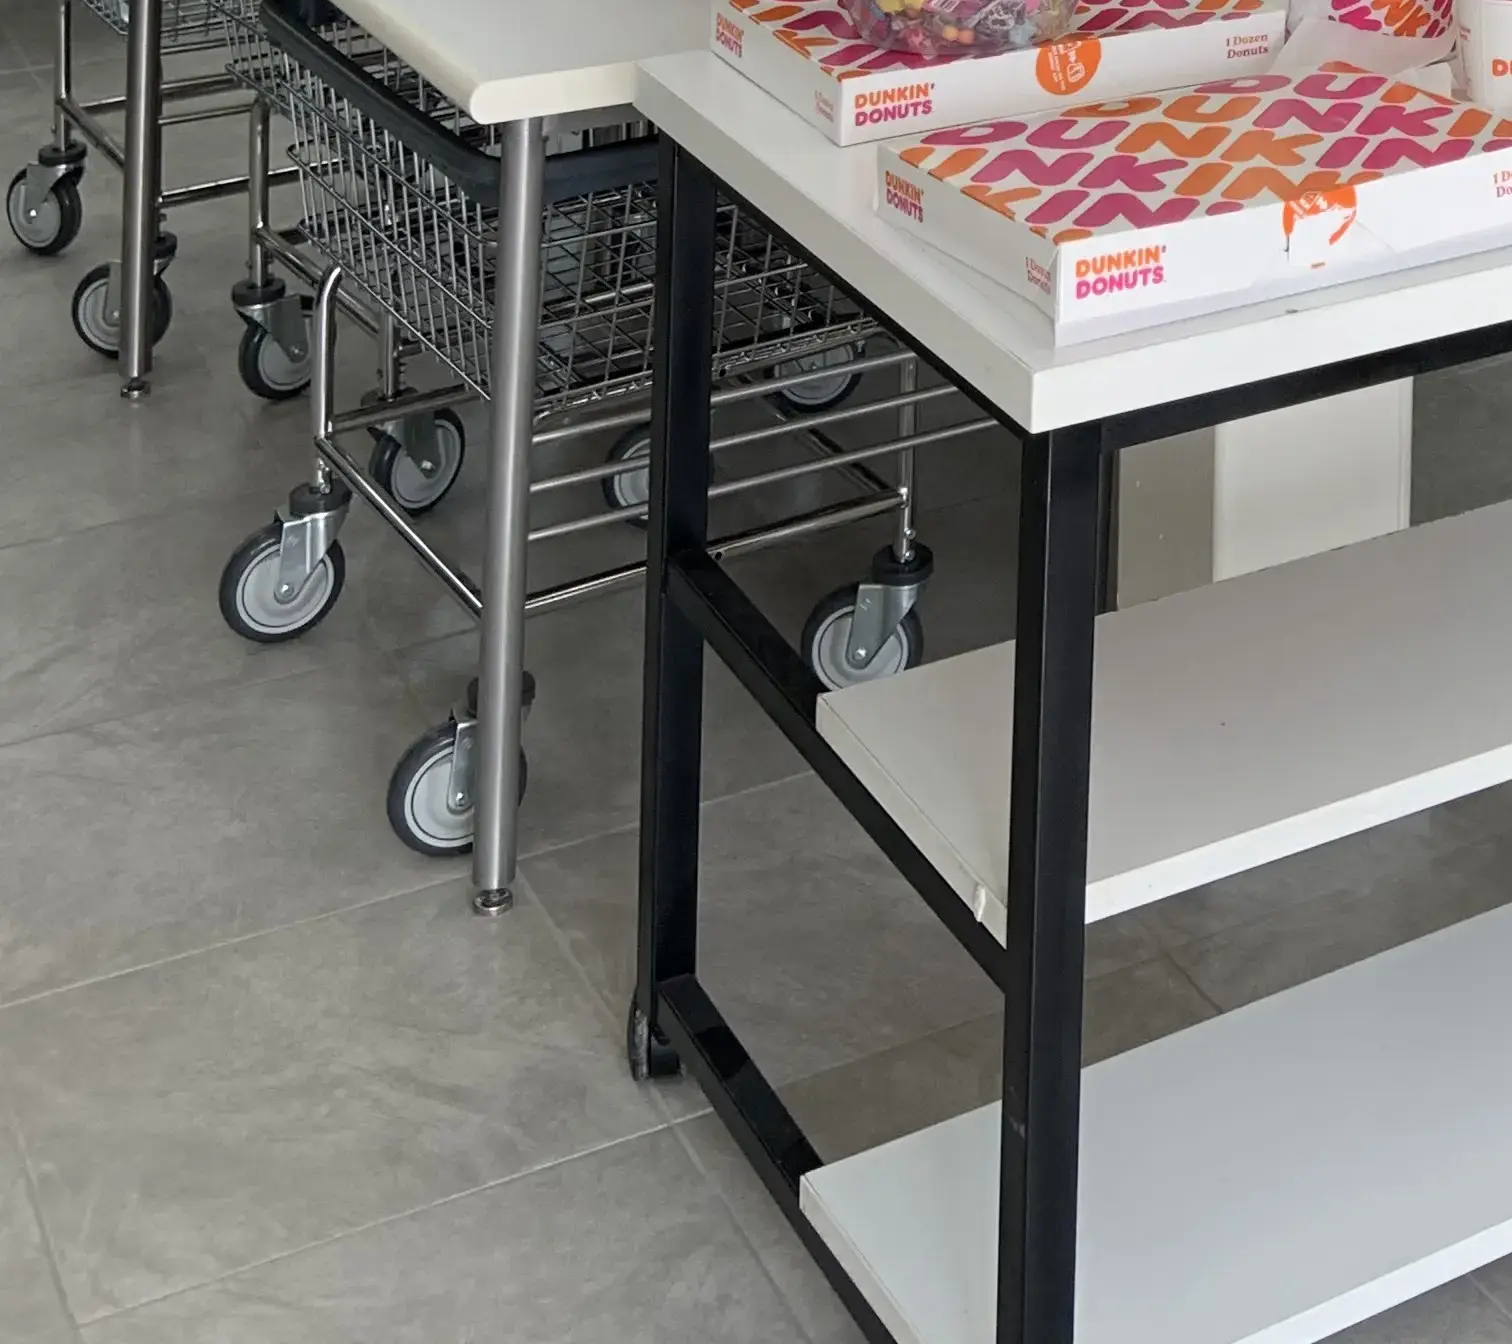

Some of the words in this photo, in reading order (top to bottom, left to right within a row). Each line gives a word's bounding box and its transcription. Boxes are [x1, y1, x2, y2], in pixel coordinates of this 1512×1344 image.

[716, 12, 745, 43] DUNKIN'
[1233, 33, 1268, 45] Dozen
[1227, 45, 1269, 59] Donuts
[854, 82, 935, 109] DUNKIN'
[854, 99, 933, 127] DONUTS
[885, 169, 925, 205] DUNKIN'
[886, 187, 924, 223] DONUTS
[1075, 244, 1167, 278] DUNKIN'
[1075, 265, 1165, 300] DONUTS
